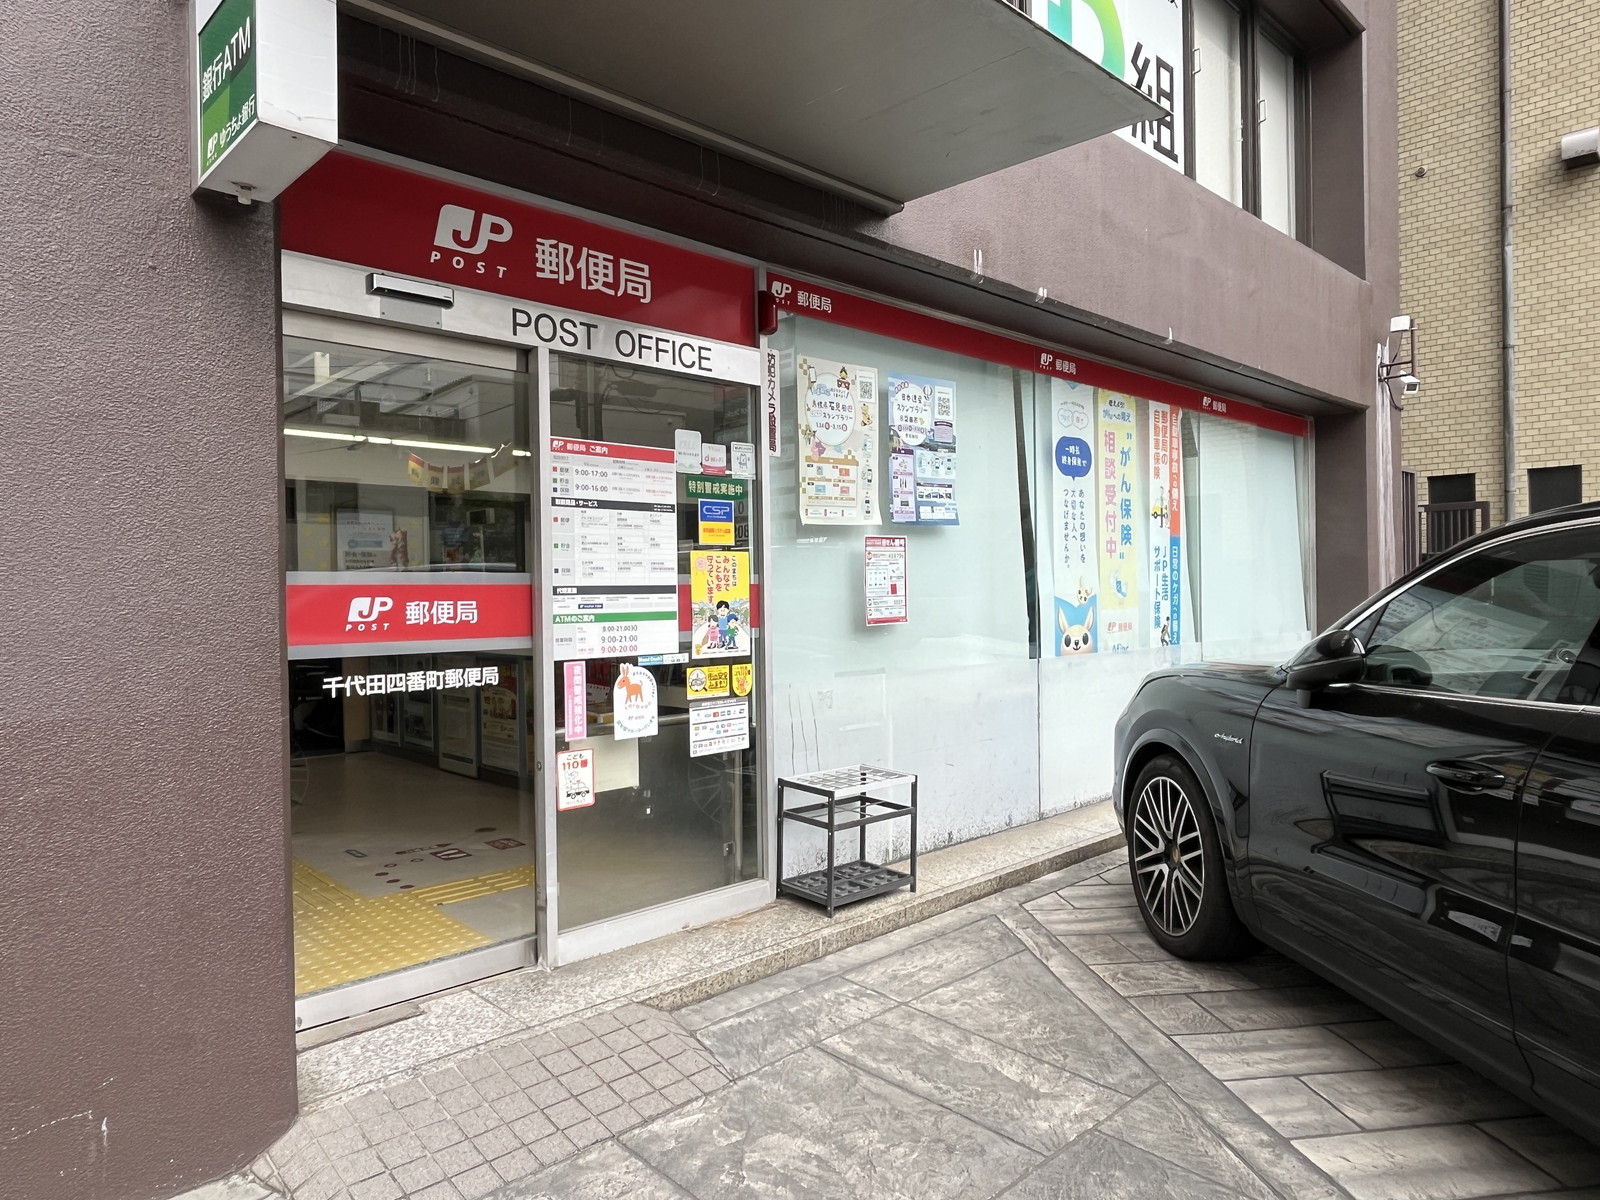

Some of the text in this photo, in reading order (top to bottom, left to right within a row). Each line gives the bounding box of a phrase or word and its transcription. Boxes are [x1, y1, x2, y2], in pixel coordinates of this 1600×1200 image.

[202, 16, 251, 103] 銀行ATM
[220, 93, 255, 148] ゆうちょ銀行
[430, 251, 507, 279] POST
[434, 204, 651, 303] JP 郵便局
[772, 281, 831, 313] JP 郵便局
[512, 307, 713, 373] POST OFFICE
[567, 443, 586, 452] 郵便局
[589, 446, 608, 455] ご案内
[575, 469, 608, 478] 9:00-17:00
[688, 480, 743, 496] 特別警戒実施中
[1104, 430, 1117, 558] 相談受付中
[703, 505, 730, 515] CSP
[347, 597, 478, 625] JP 郵便局
[555, 614, 595, 623] ATMのご案内
[345, 623, 390, 631] POST
[322, 666, 499, 698] 千代田四番町郵便局
[562, 759, 588, 770] 110
